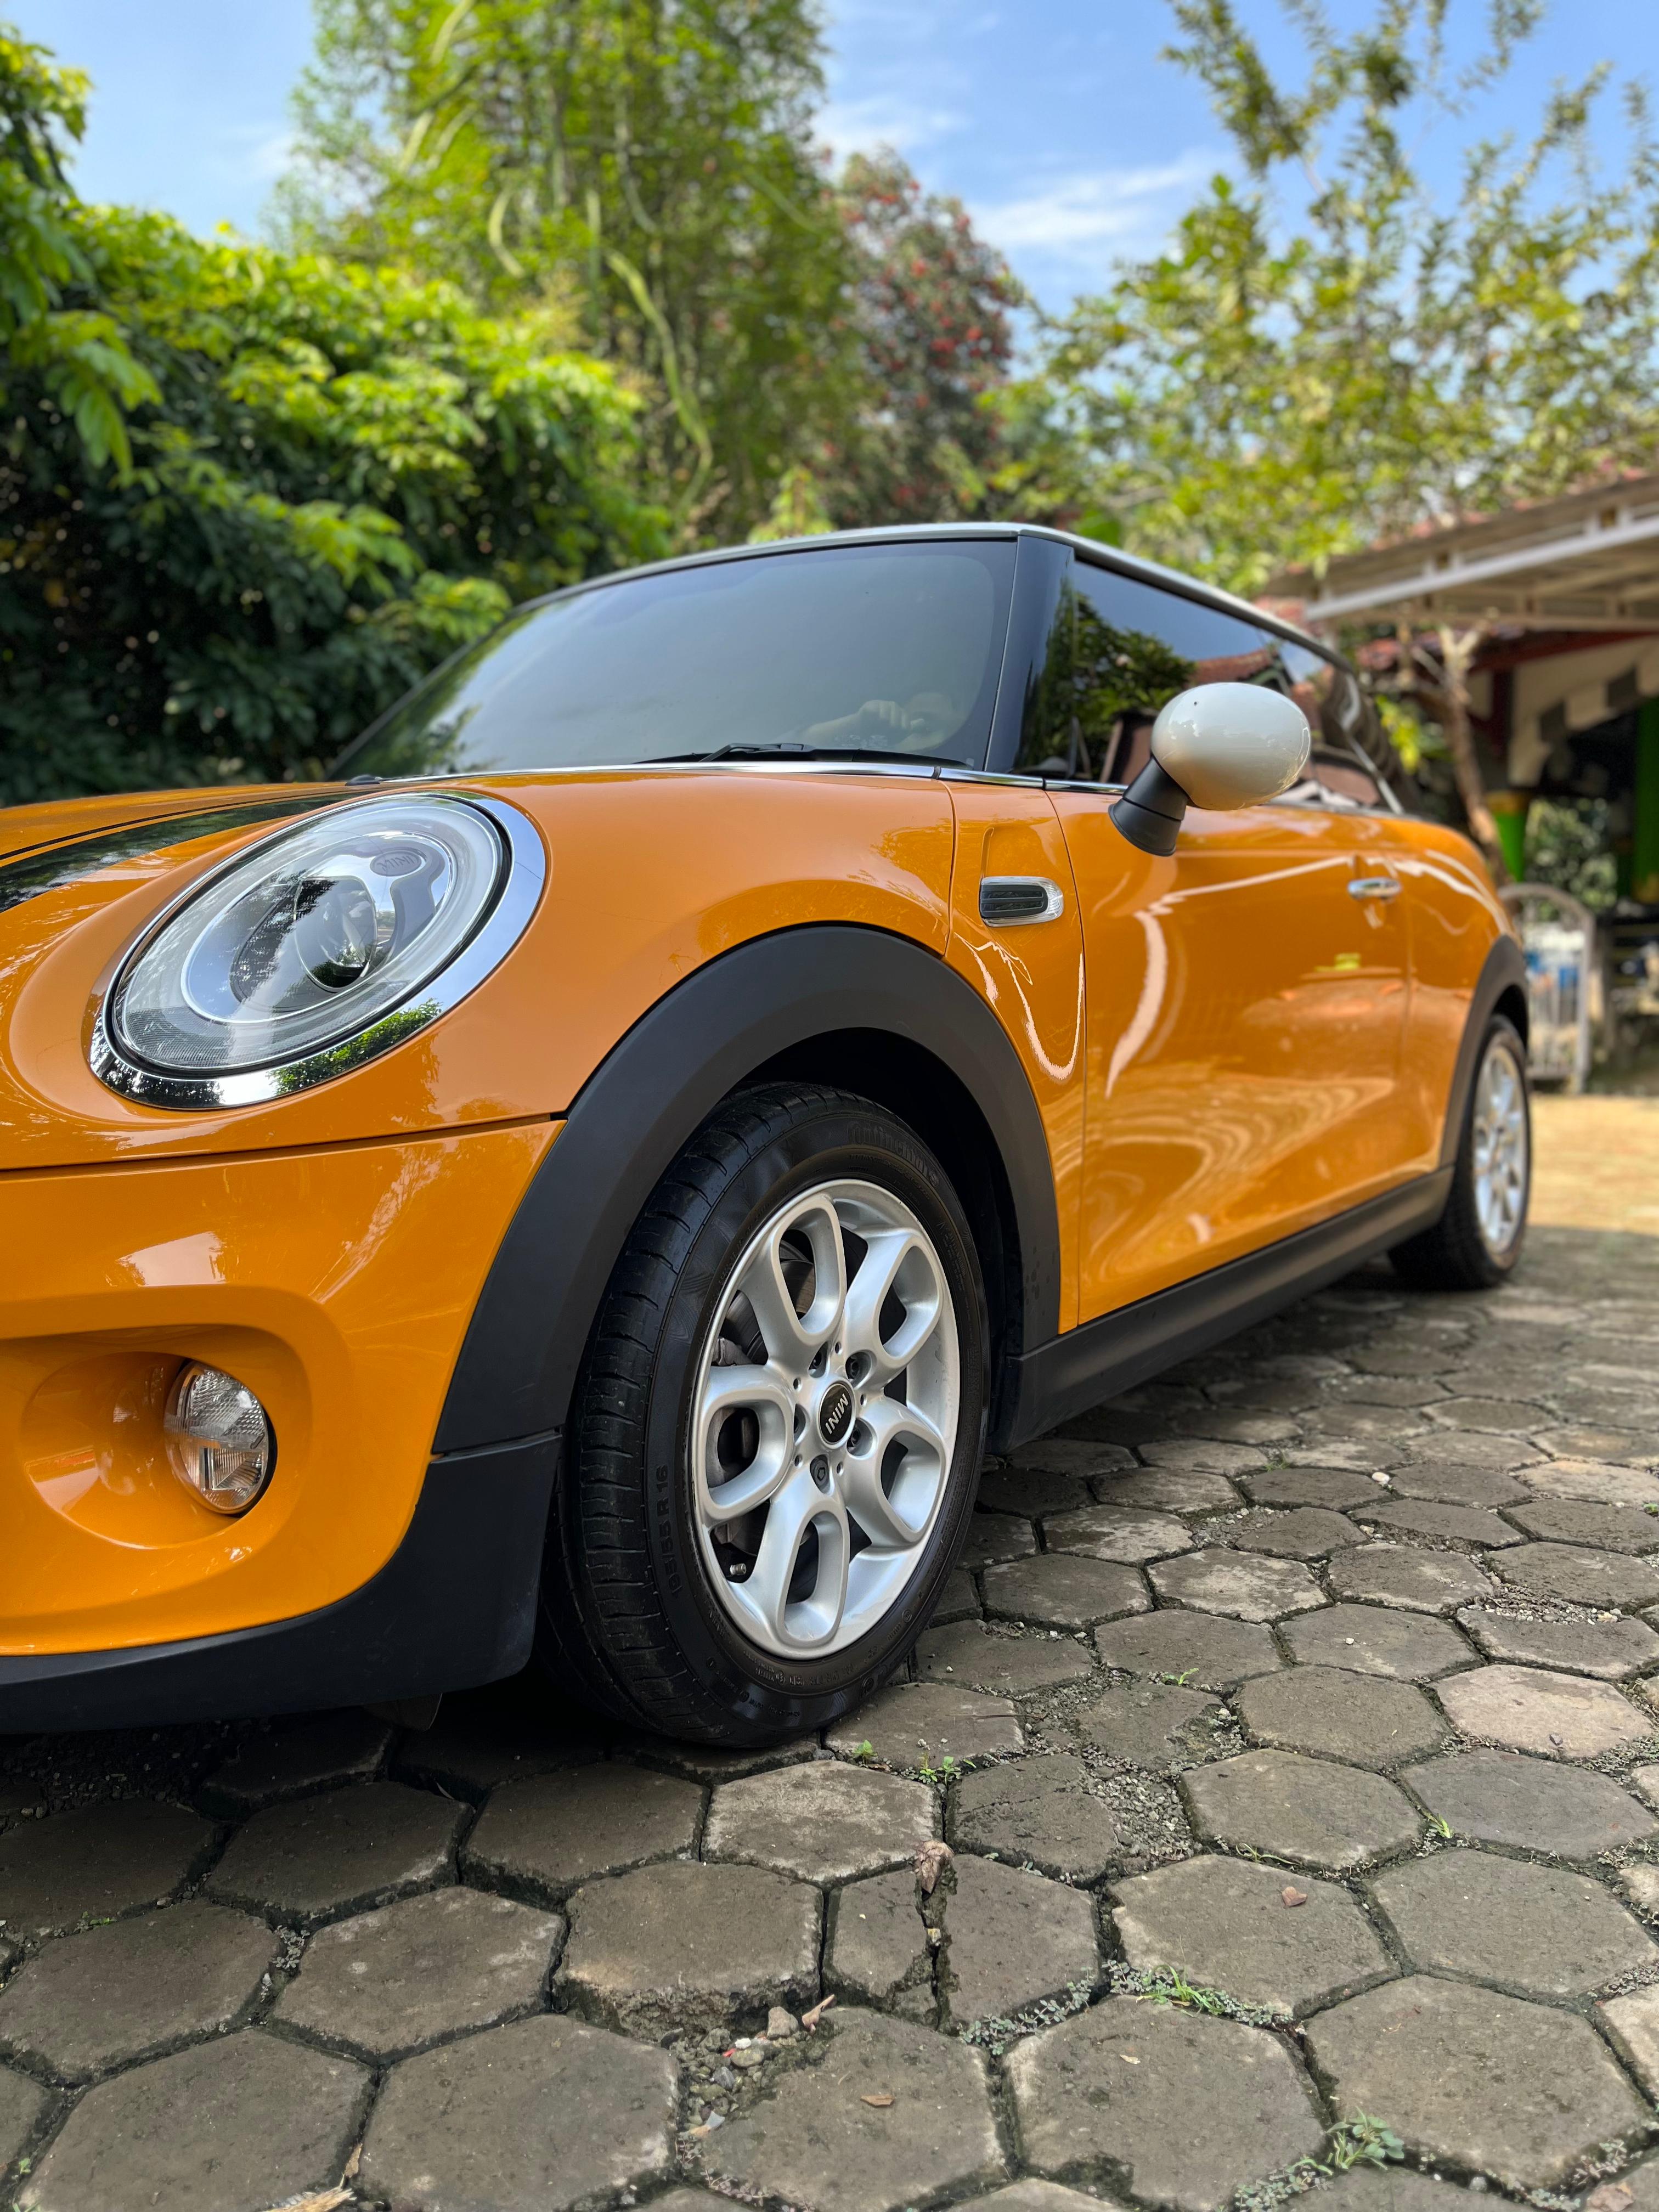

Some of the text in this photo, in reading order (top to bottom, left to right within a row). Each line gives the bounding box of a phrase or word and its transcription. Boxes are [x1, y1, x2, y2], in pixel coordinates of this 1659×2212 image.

[377, 855, 415, 872] MINI
[825, 1393, 849, 1435] MINI
[656, 1464, 669, 1493] 16
[657, 1497, 670, 1517] R
